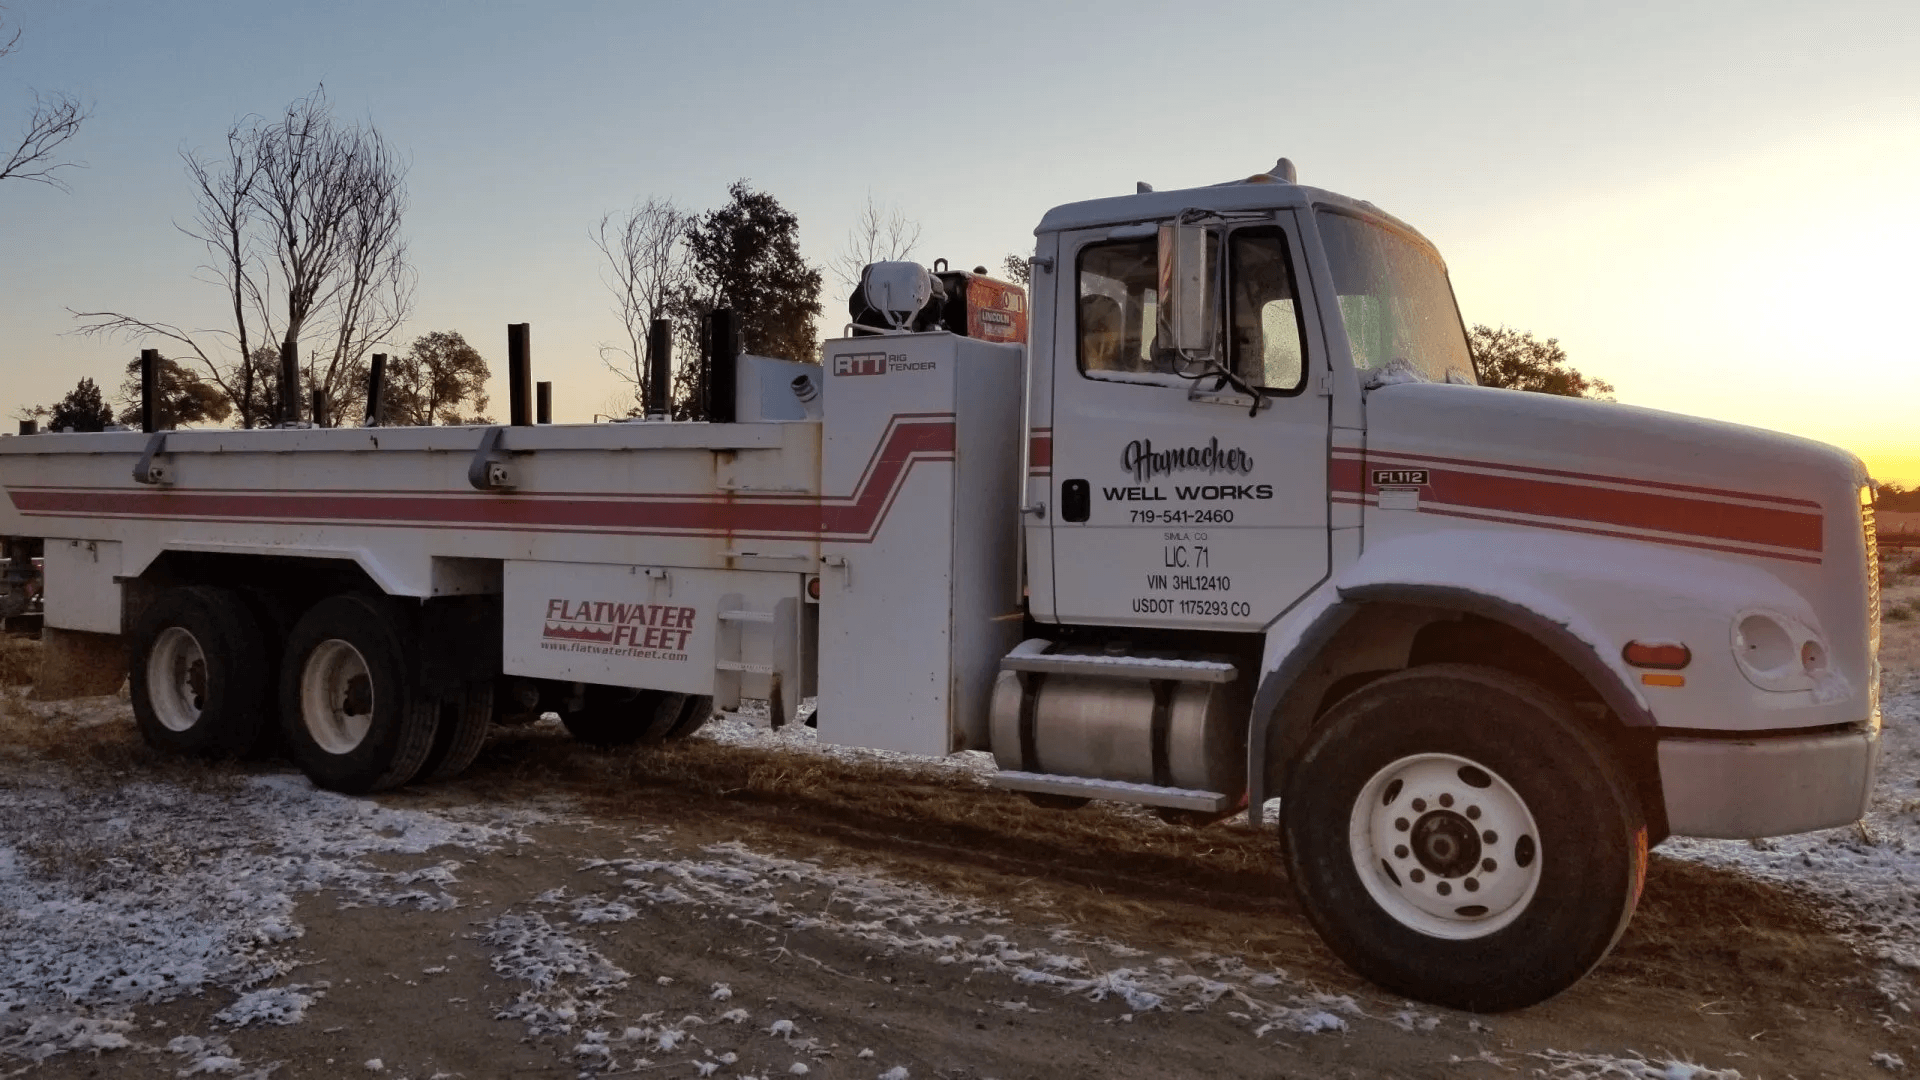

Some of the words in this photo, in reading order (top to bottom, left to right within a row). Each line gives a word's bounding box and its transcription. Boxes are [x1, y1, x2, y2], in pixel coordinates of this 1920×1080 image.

[982, 310, 1010, 324] LINCOLN
[889, 354, 907, 362] RIG
[889, 362, 936, 372] TENDER
[1120, 435, 1253, 484] Hamacher
[1378, 472, 1423, 483] FL112
[1103, 487, 1167, 501] WELL
[1175, 485, 1274, 500] WORKS
[1130, 510, 1234, 523] 719-541-2460
[1164, 532, 1189, 541] SIMLA
[1194, 533, 1208, 541] CO
[1165, 546, 1190, 568] LIC.
[1194, 547, 1209, 568] 71
[1147, 575, 1167, 590] VIN
[1173, 575, 1231, 591] 3HL12410
[546, 599, 696, 629] FLATWATER
[1132, 599, 1174, 614] USDOT
[1179, 600, 1229, 616] 1175293
[1231, 601, 1250, 617] CO
[613, 626, 692, 651] FLEET
[541, 641, 688, 661] www.flatwaterfleet.com
